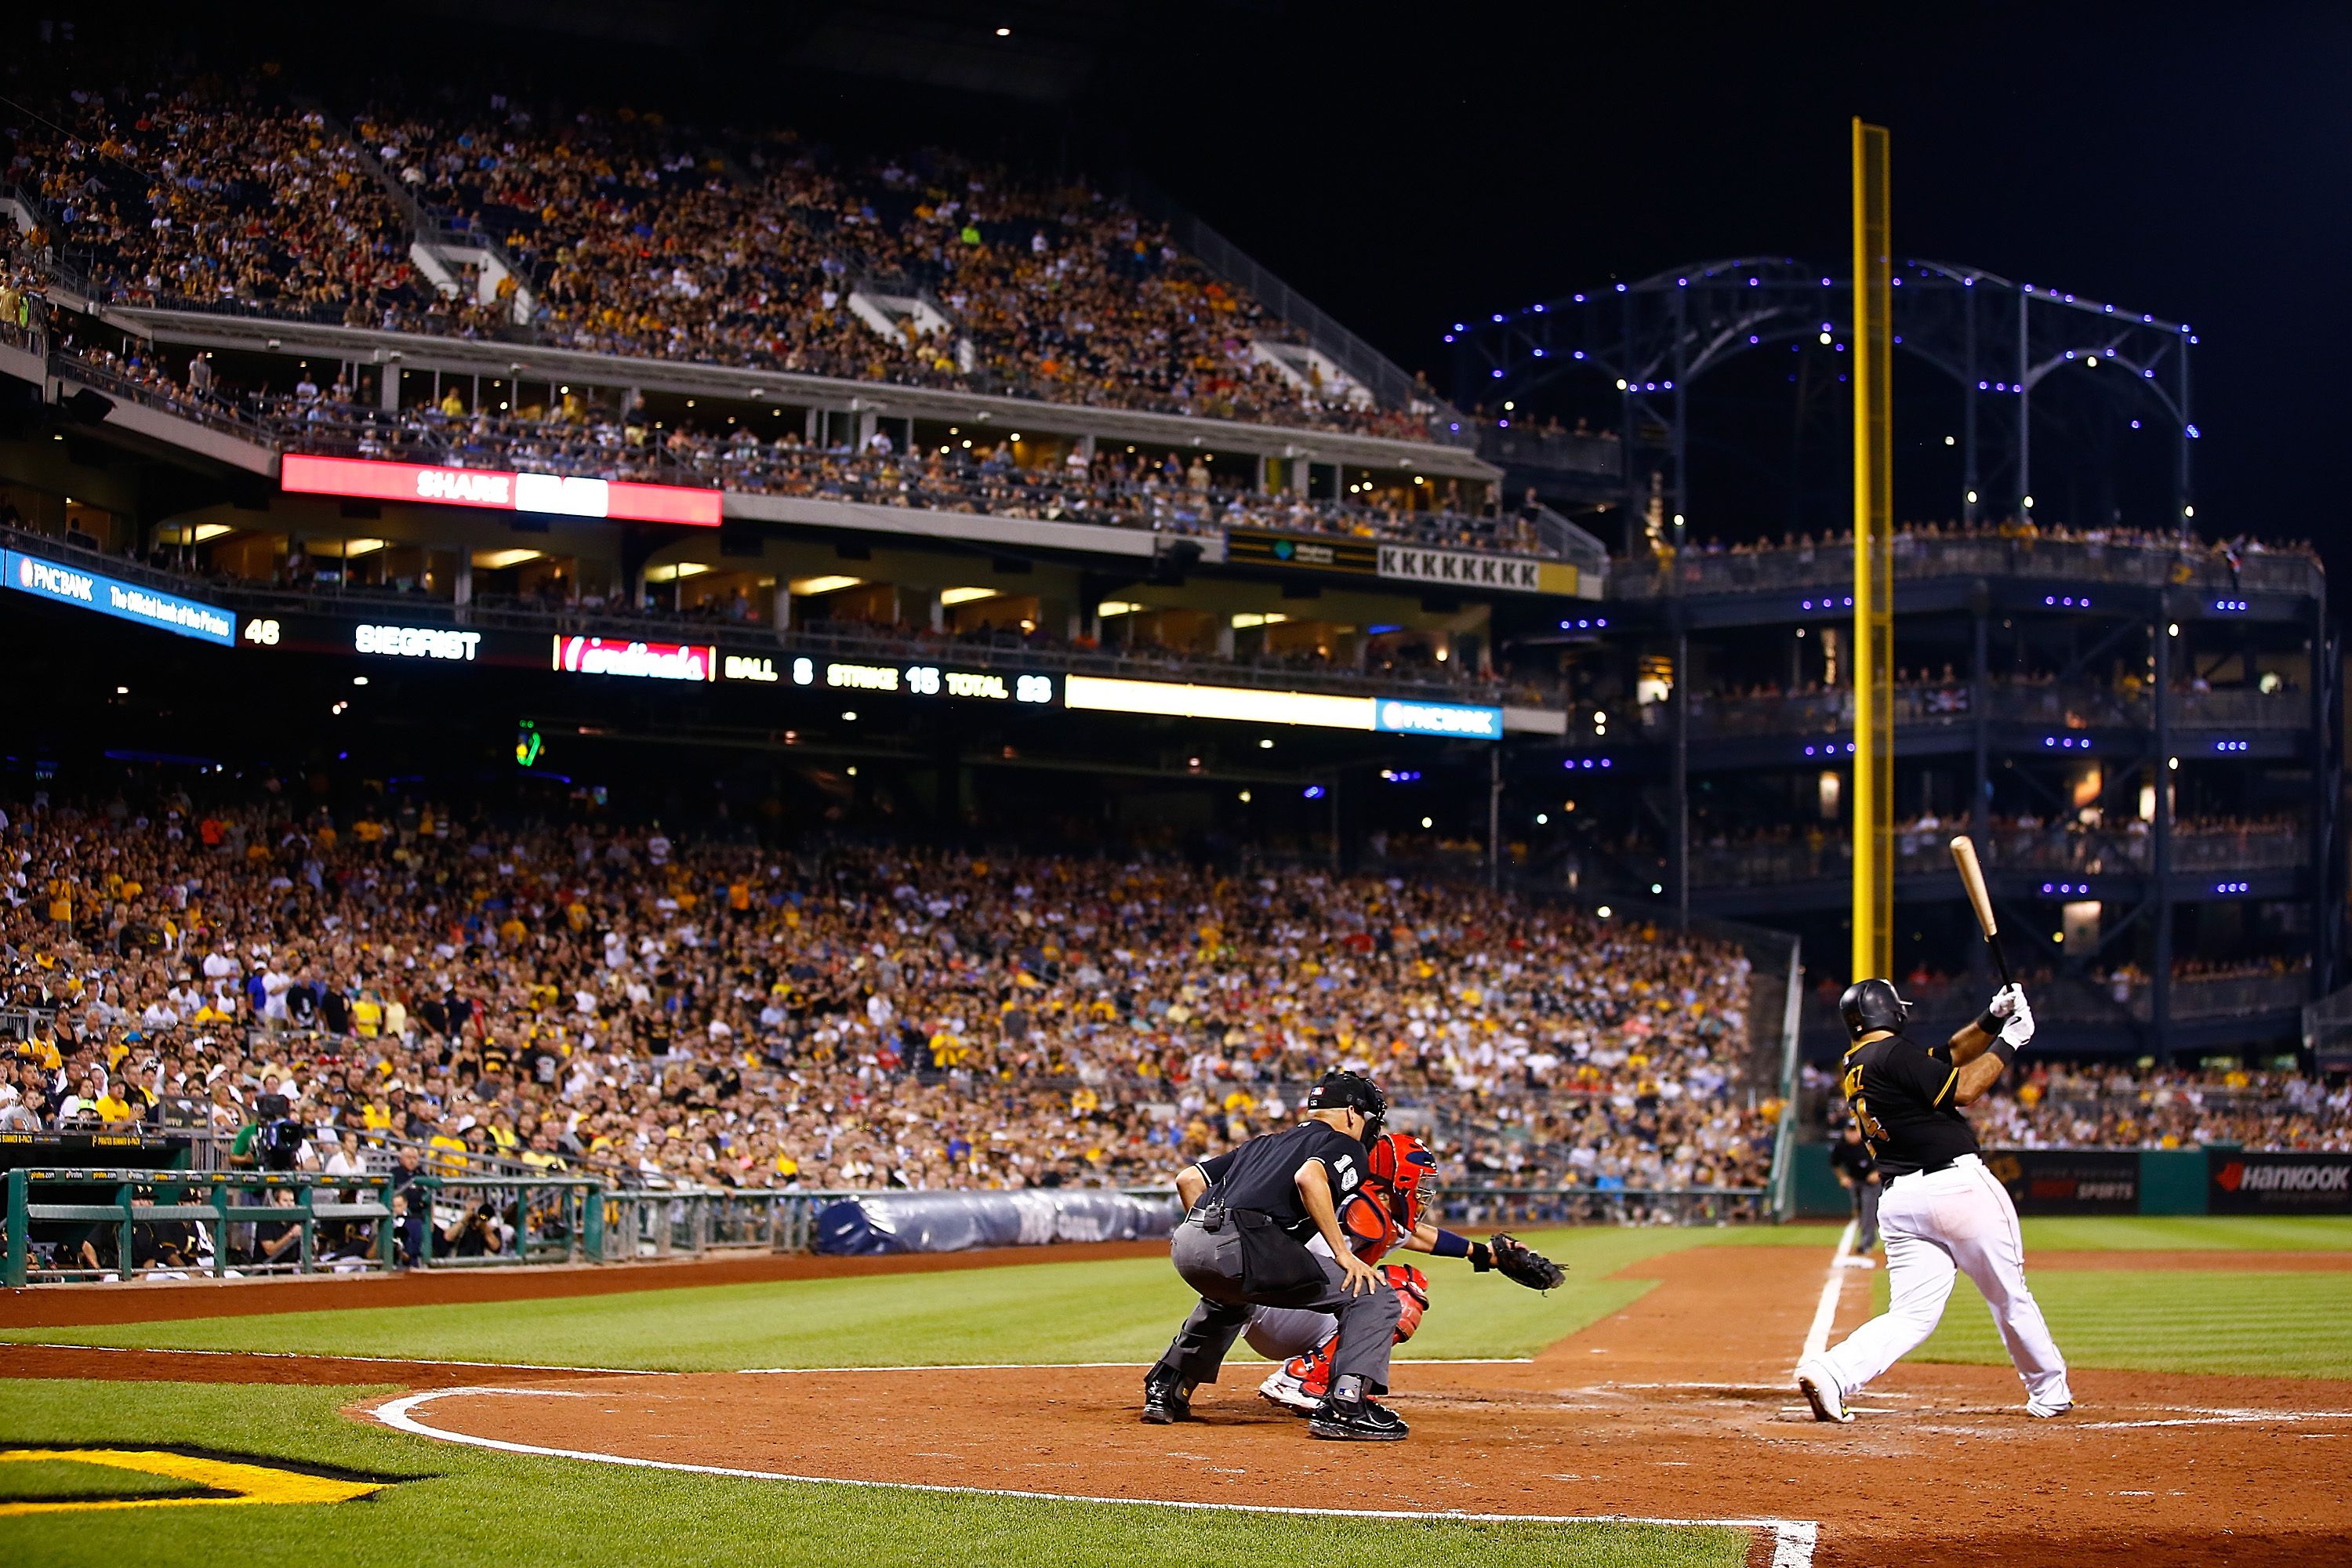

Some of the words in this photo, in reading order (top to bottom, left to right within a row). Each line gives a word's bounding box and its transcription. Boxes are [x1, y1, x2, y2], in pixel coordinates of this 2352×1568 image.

[416, 470, 509, 503] SHARE
[110, 585, 127, 609] The
[127, 590, 157, 618] Official
[177, 605, 187, 626] of
[186, 607, 200, 630] the
[200, 610, 230, 637] Pirates
[245, 619, 280, 644] 46
[355, 625, 481, 660] SIEGRIST
[564, 636, 706, 681] Cardinals
[725, 655, 779, 681] BALL
[827, 664, 898, 690] STRIKE
[905, 666, 940, 695] 15
[946, 673, 1009, 699] TOTAL
